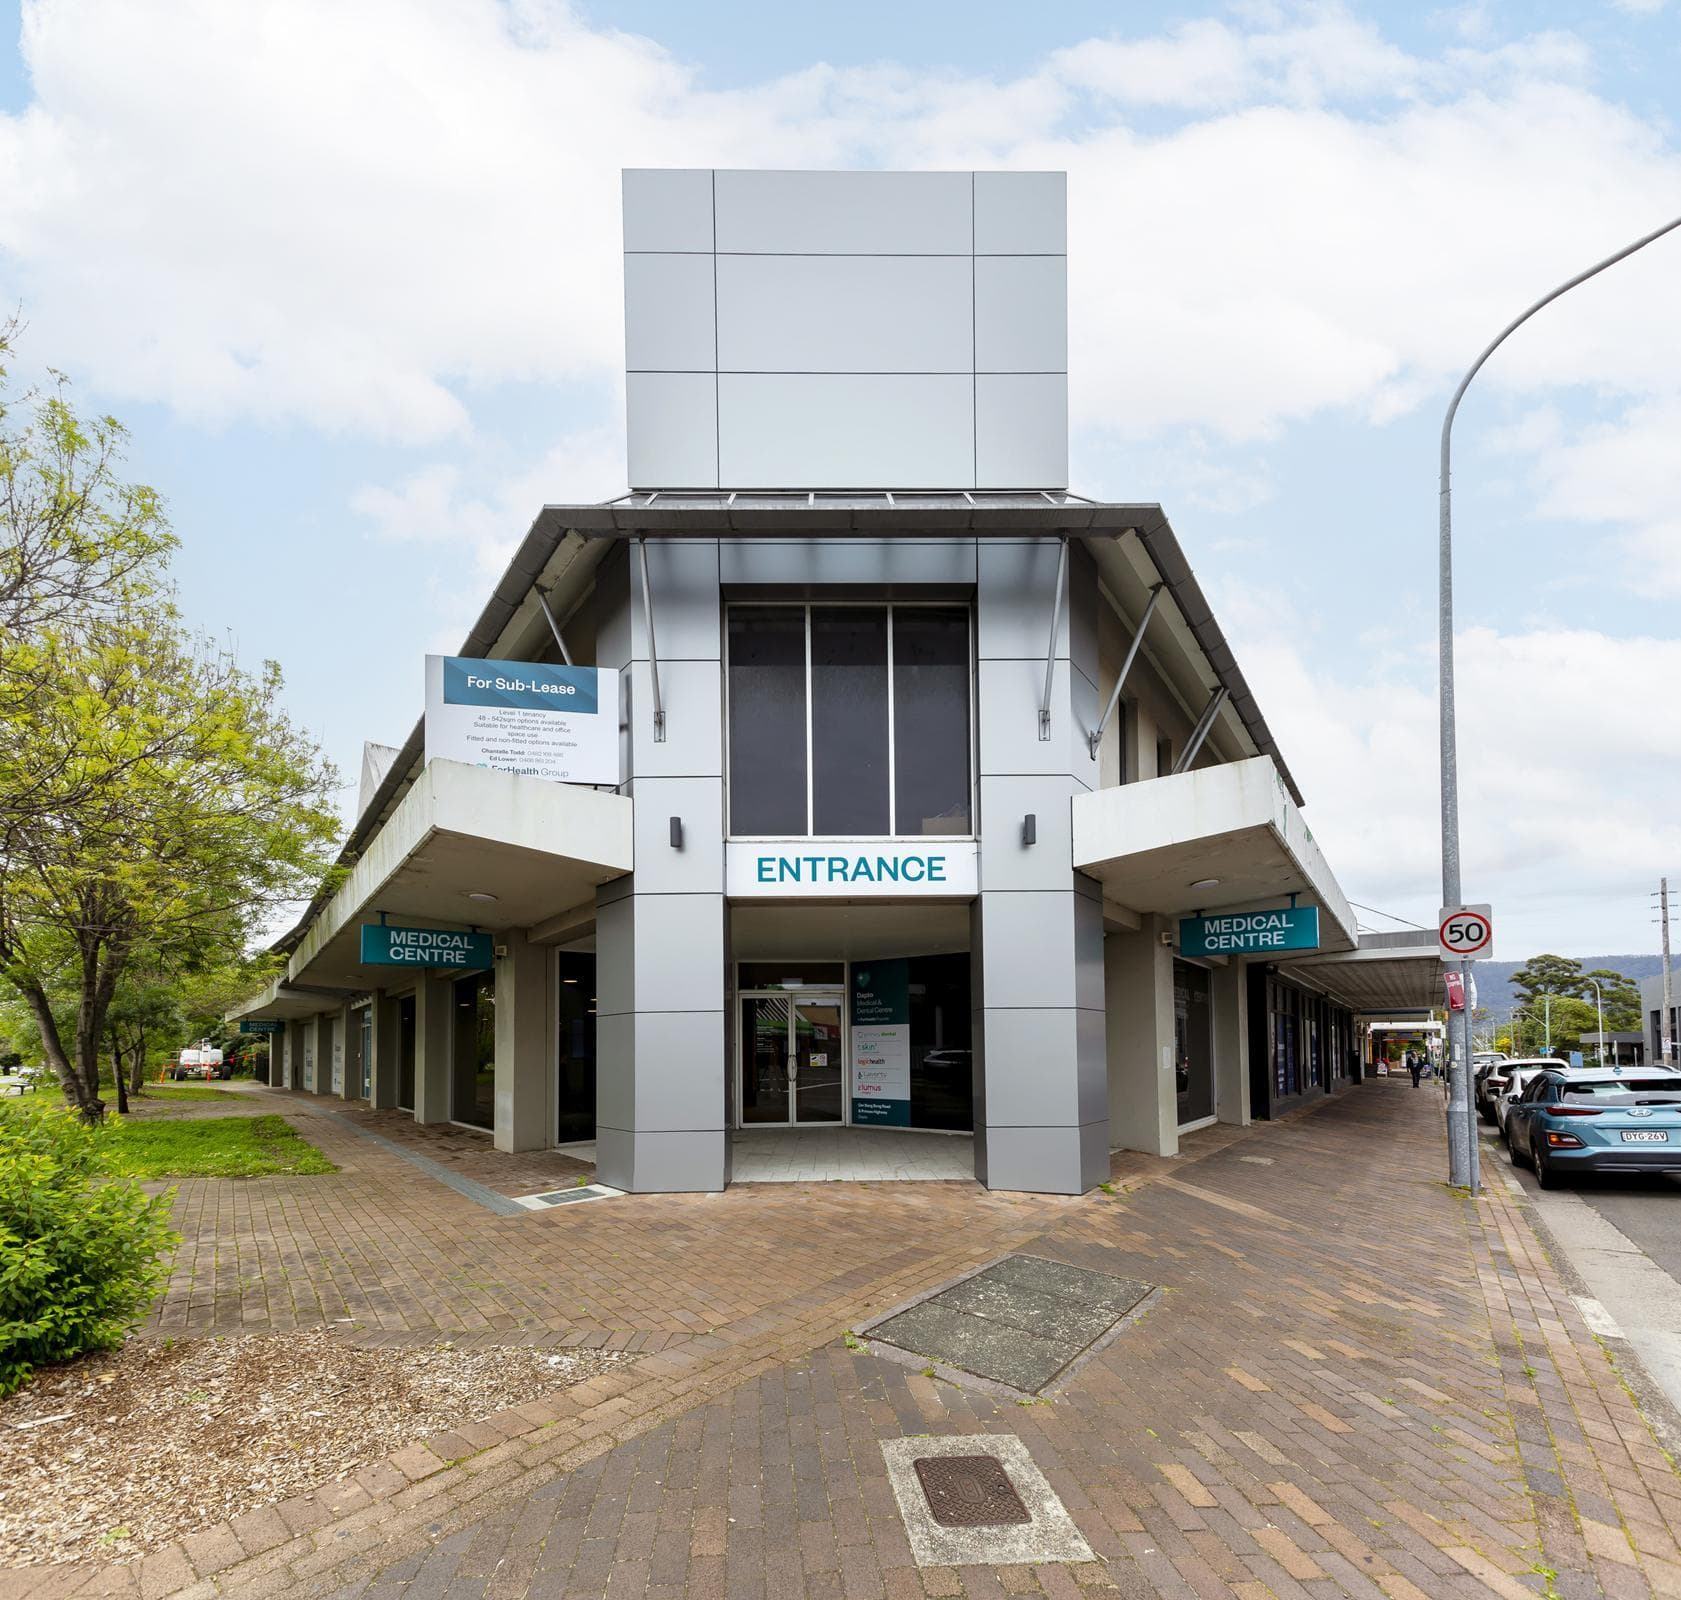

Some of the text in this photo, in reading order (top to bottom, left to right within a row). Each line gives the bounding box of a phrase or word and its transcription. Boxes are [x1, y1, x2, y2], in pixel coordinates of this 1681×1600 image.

[467, 676, 576, 695] For Sub-Lease
[517, 717, 539, 726] options
[522, 711, 547, 719] tenancy
[473, 721, 498, 729] Suitable
[509, 723, 541, 732] healthcare
[542, 725, 554, 733] and
[555, 726, 571, 734] office
[508, 731, 526, 739] space
[466, 735, 485, 743] Fitted
[528, 739, 550, 747] options
[541, 767, 569, 778] Group
[757, 856, 947, 883] ENTRANCE
[1204, 913, 1294, 935] MEDICAL
[1448, 922, 1484, 943] 50
[390, 930, 475, 950] MEDICAL
[1204, 930, 1286, 950] CENTRE
[389, 946, 467, 964] CENTRE
